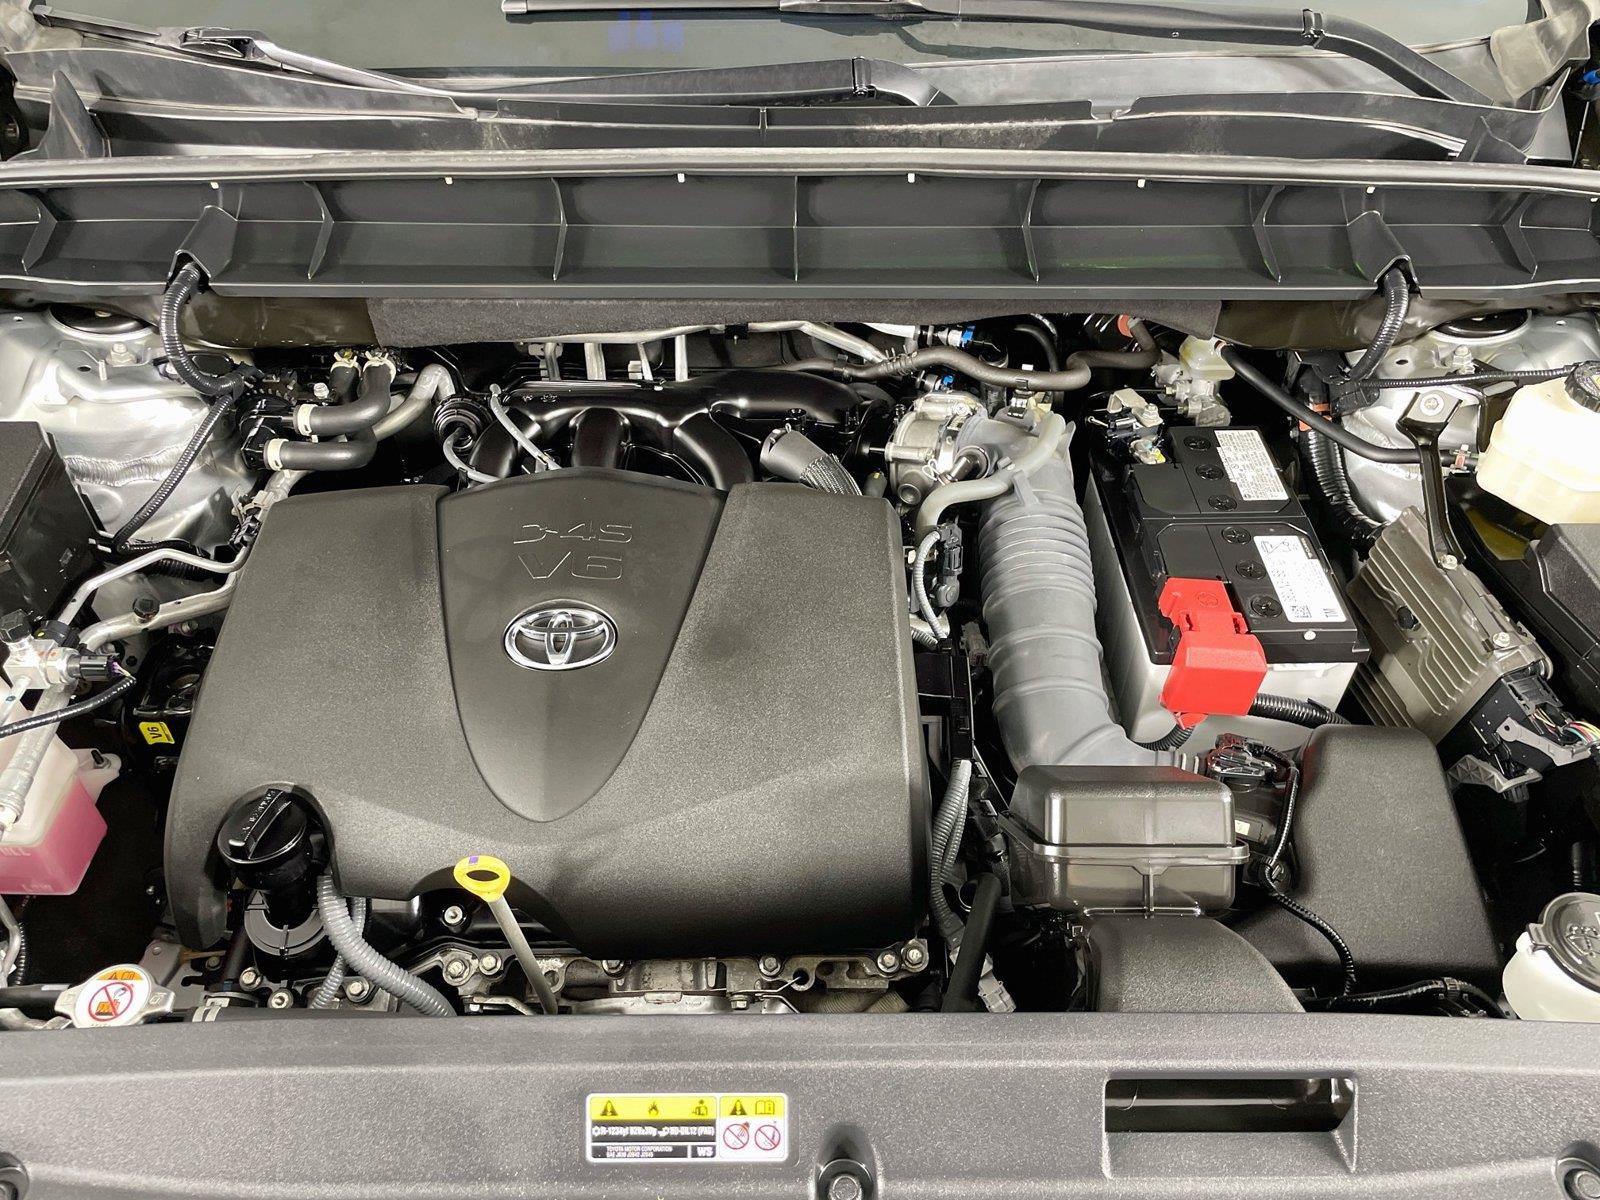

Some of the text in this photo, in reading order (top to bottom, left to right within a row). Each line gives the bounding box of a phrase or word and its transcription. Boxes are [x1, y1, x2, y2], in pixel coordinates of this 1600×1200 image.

[517, 551, 623, 580] V6
[147, 726, 163, 739] V6
[697, 1146, 714, 1157] WS
